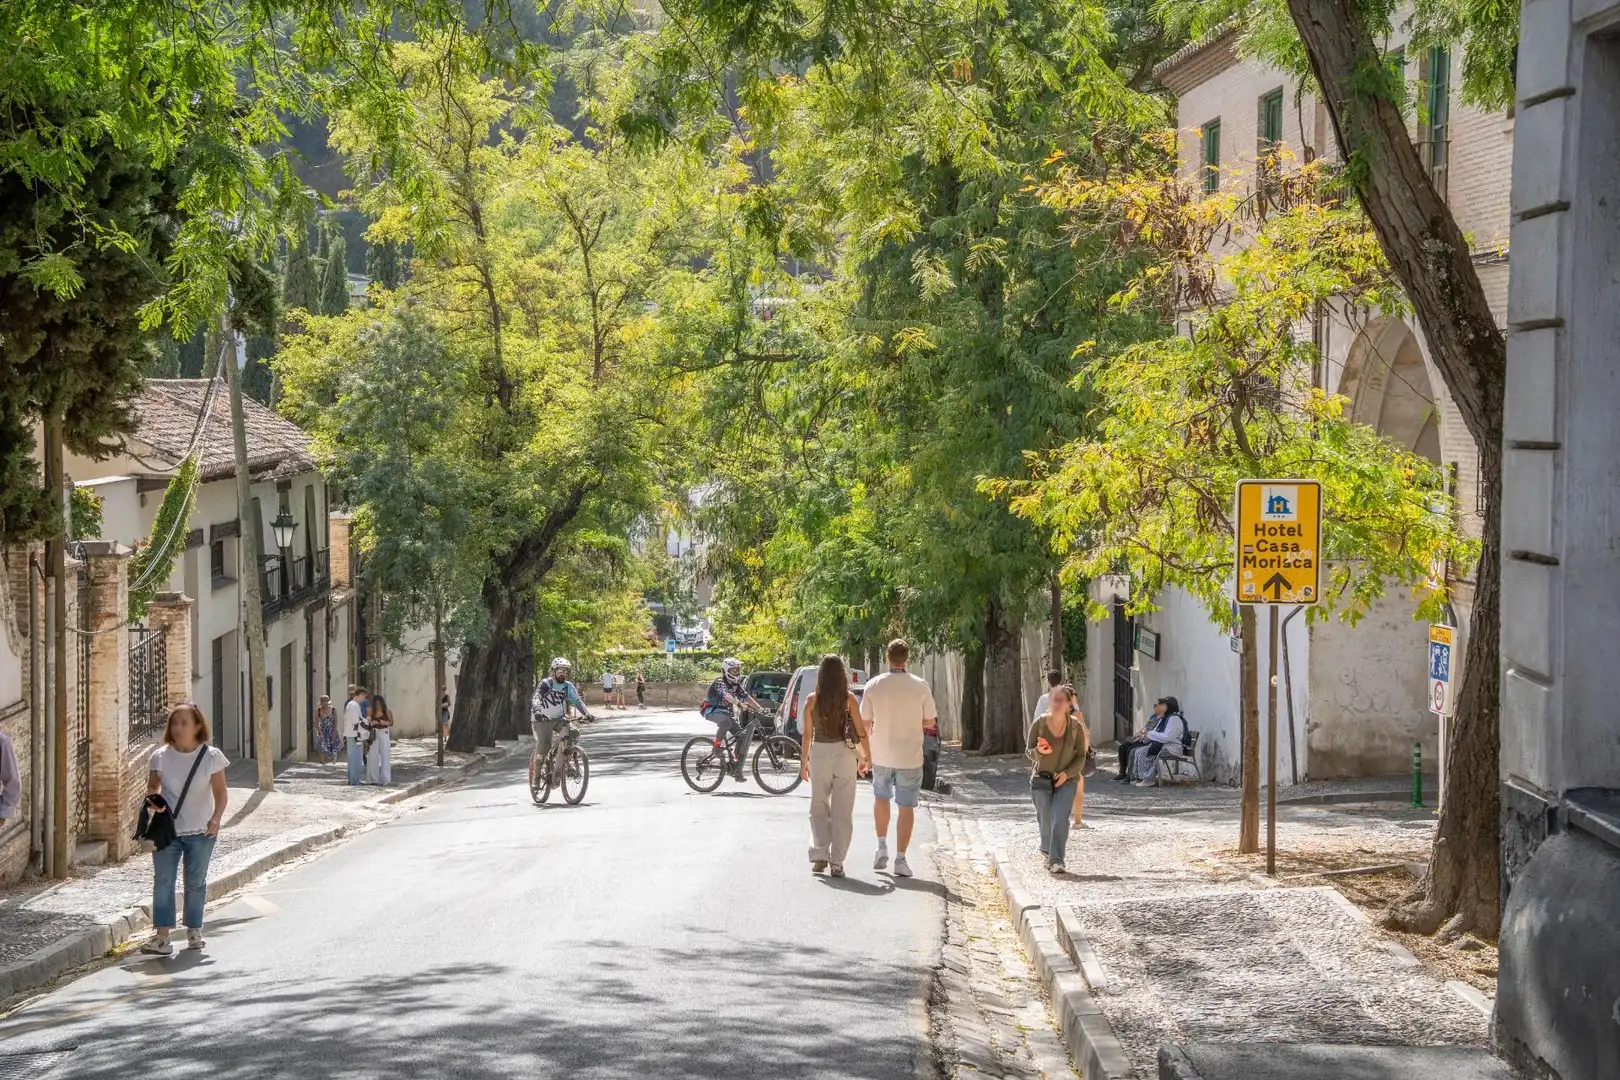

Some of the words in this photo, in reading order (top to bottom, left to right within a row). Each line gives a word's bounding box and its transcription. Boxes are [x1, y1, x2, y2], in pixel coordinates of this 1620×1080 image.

[1273, 500, 1284, 512] H
[1254, 523, 1303, 537] Hotel
[1256, 539, 1300, 552] Casa
[1243, 555, 1312, 568] Morisca
